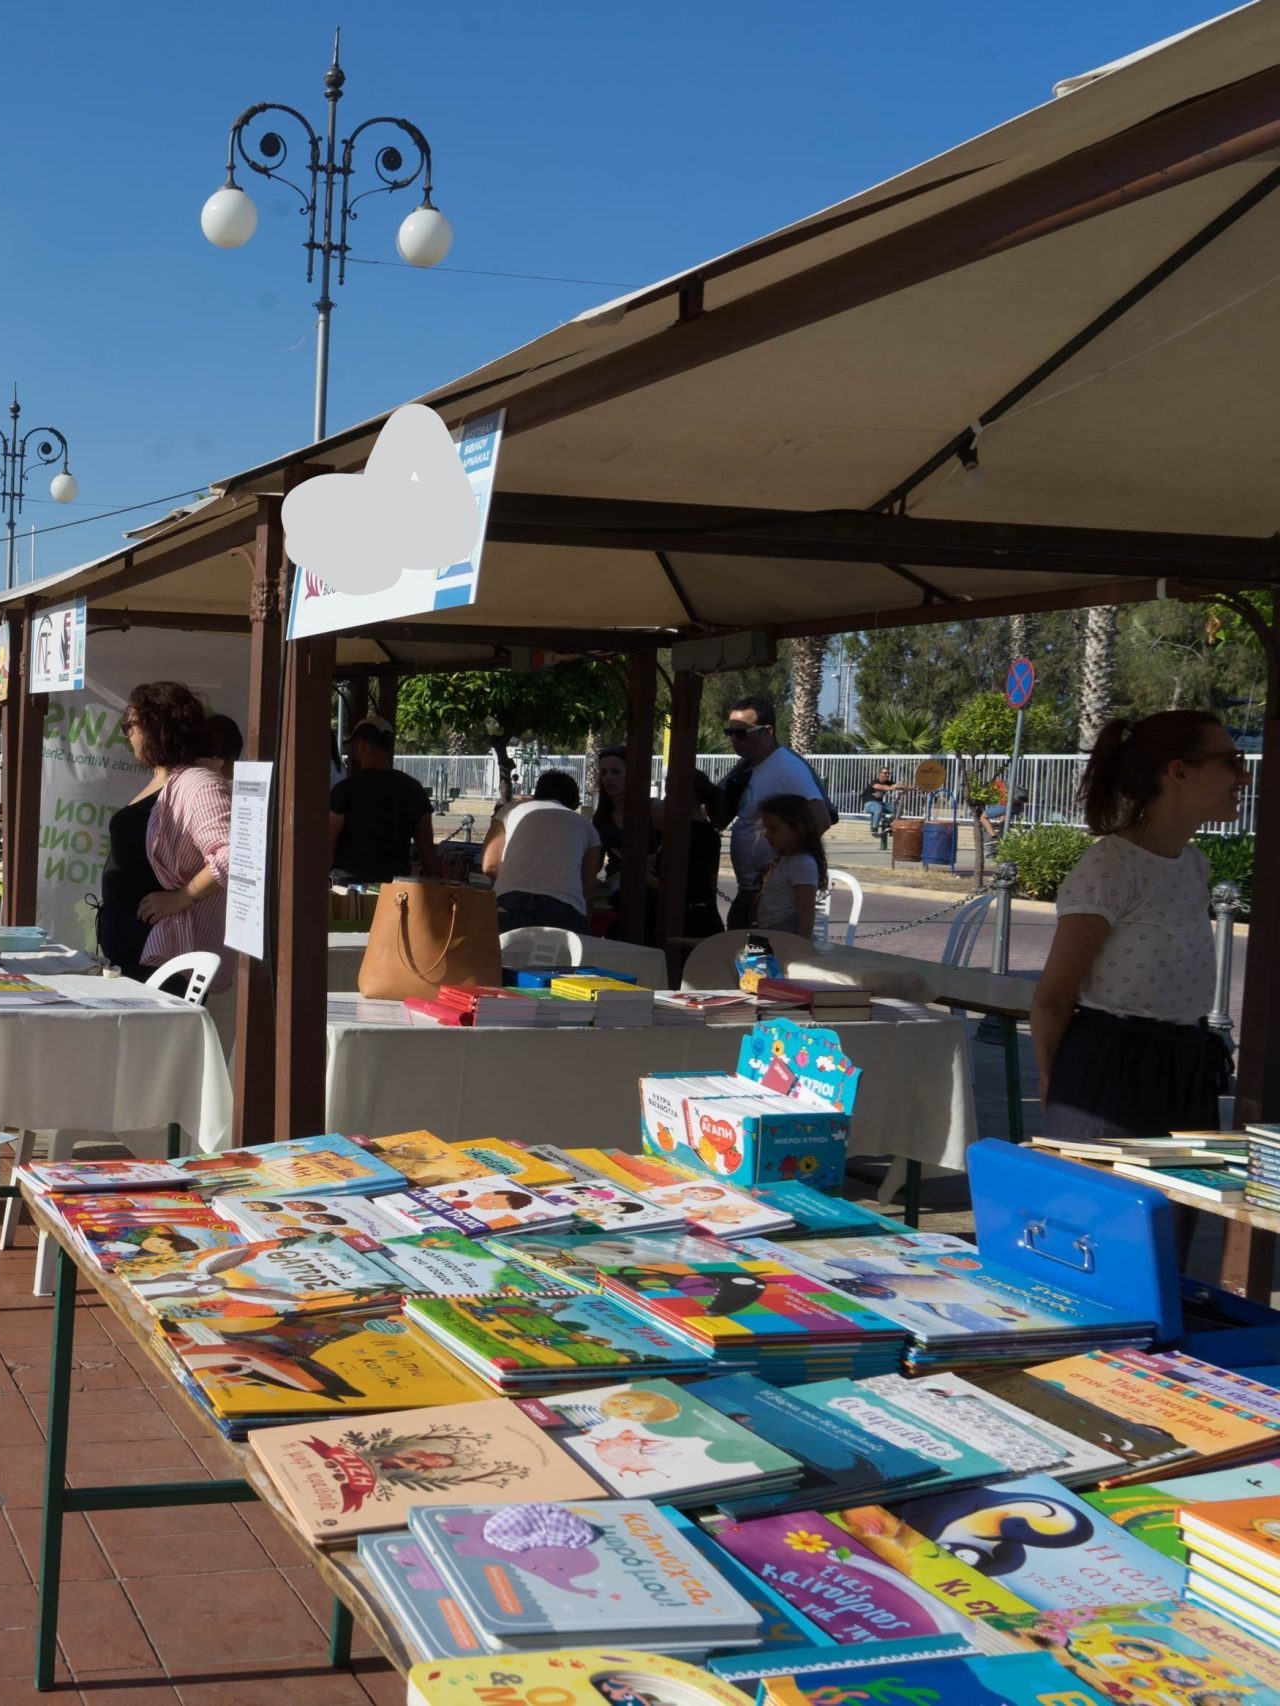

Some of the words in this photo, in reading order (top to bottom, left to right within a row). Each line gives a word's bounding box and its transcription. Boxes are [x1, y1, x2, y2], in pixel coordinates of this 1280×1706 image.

[701, 1120, 734, 1141] ΑΓΑΠΗ
[774, 1137, 802, 1145] ΜΙΚΡΟΙ
[803, 1136, 828, 1144] ΚΥΡΙΟΙ
[1070, 1373, 1107, 1389] στον
[1156, 1406, 1177, 1419] τα
[331, 1453, 374, 1487] ΖΙΖΗ
[598, 1524, 654, 1567] μωρό
[1083, 1544, 1125, 1564] Η
